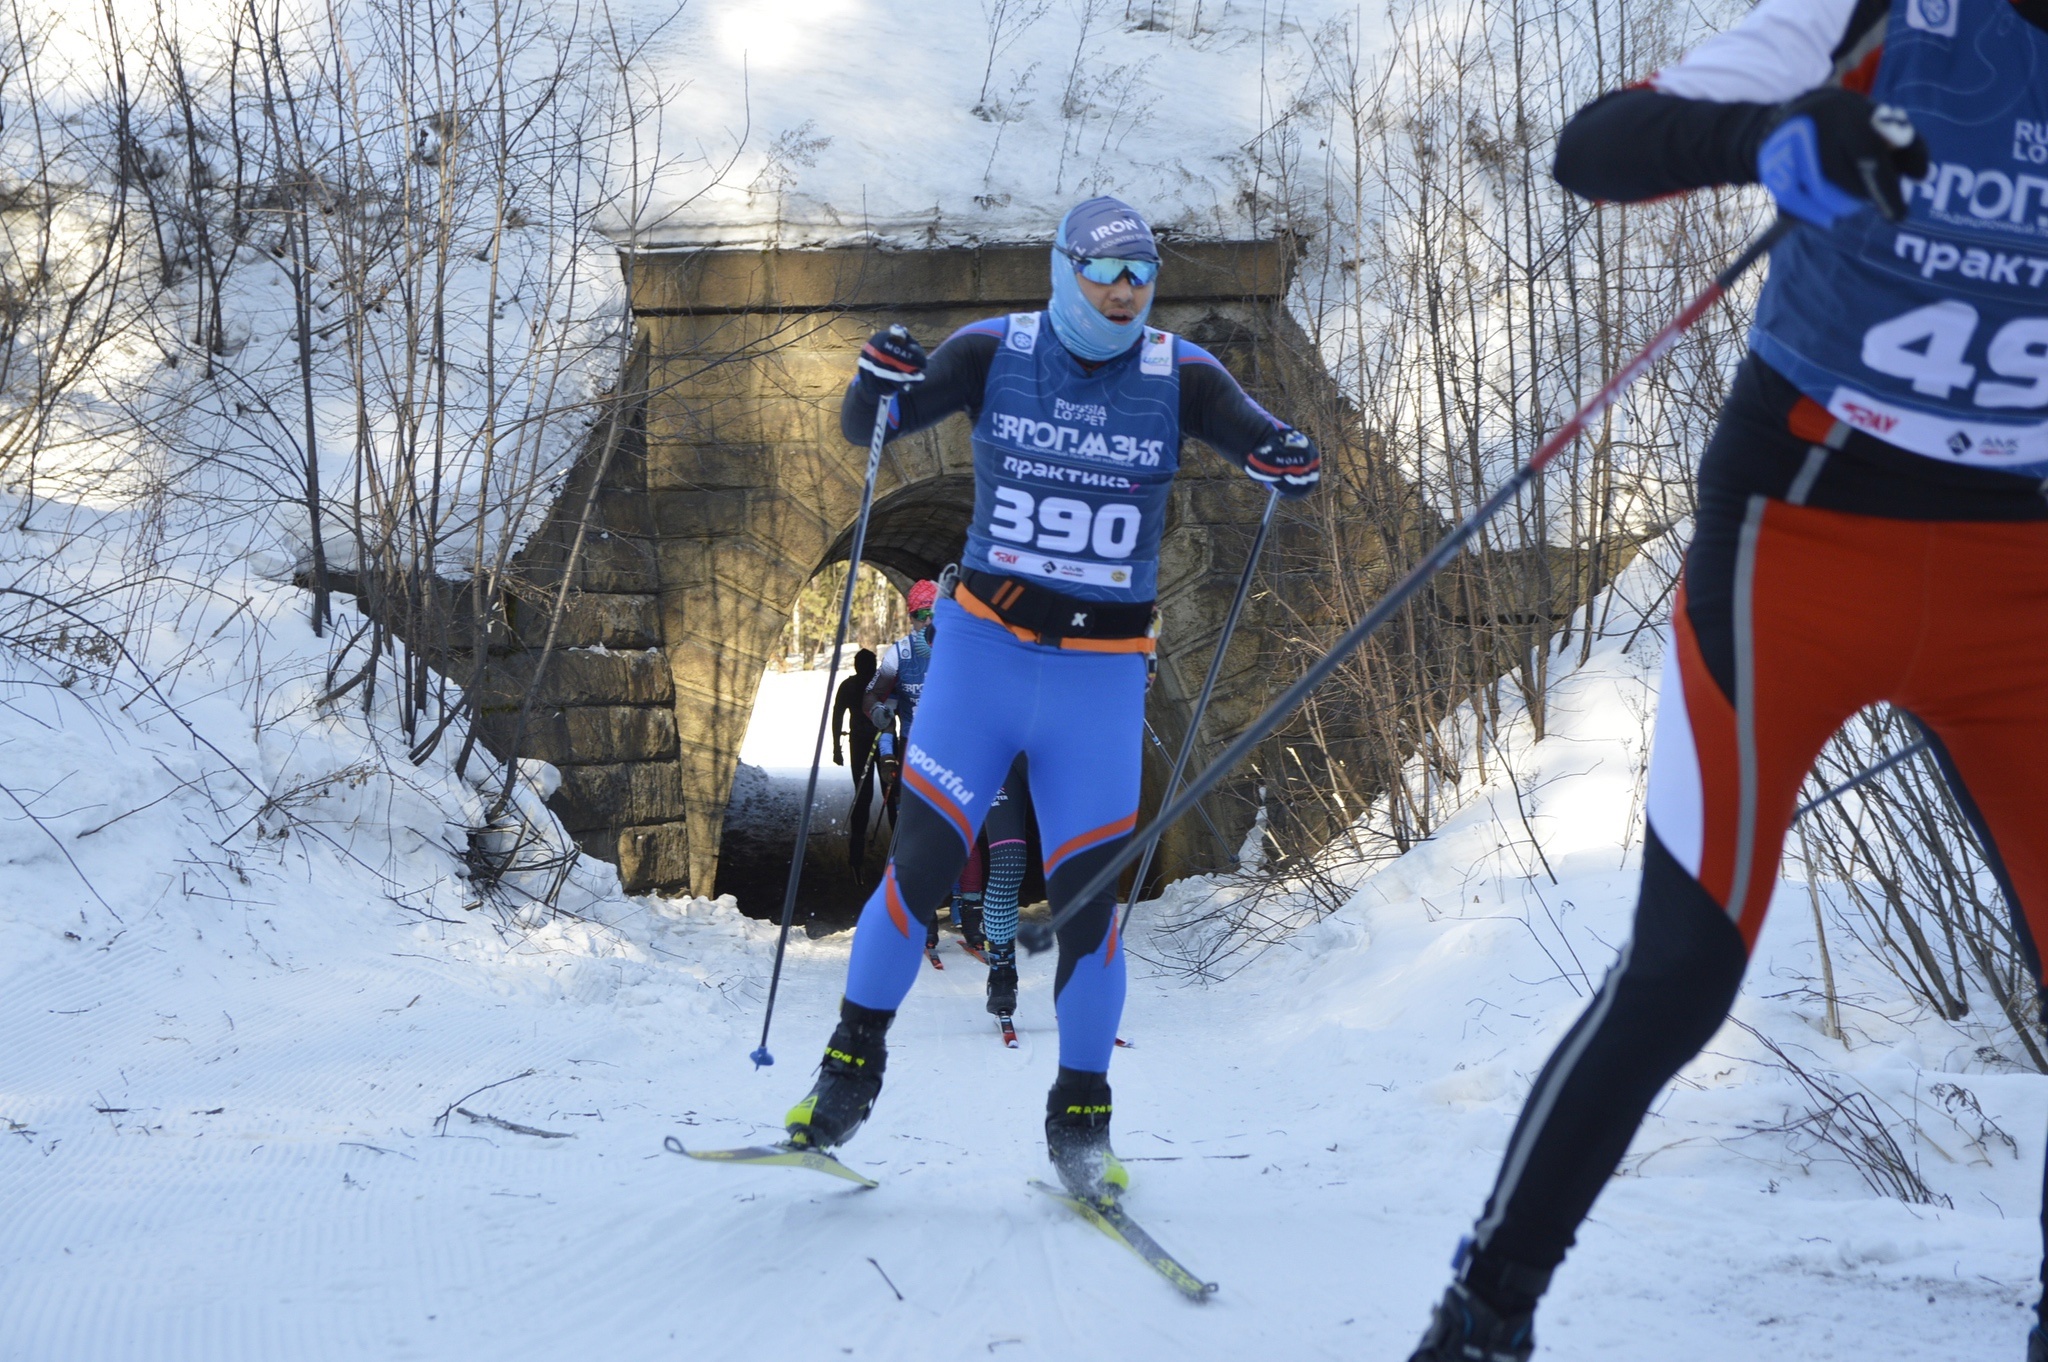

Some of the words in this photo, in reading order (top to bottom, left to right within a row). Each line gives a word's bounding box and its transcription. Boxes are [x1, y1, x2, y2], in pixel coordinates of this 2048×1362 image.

[1090, 218, 1138, 242] IRON
[1055, 397, 1108, 417] RUSSIA
[1003, 456, 1132, 489] практика
[988, 485, 1142, 559] 390
[908, 743, 975, 805] sportful
